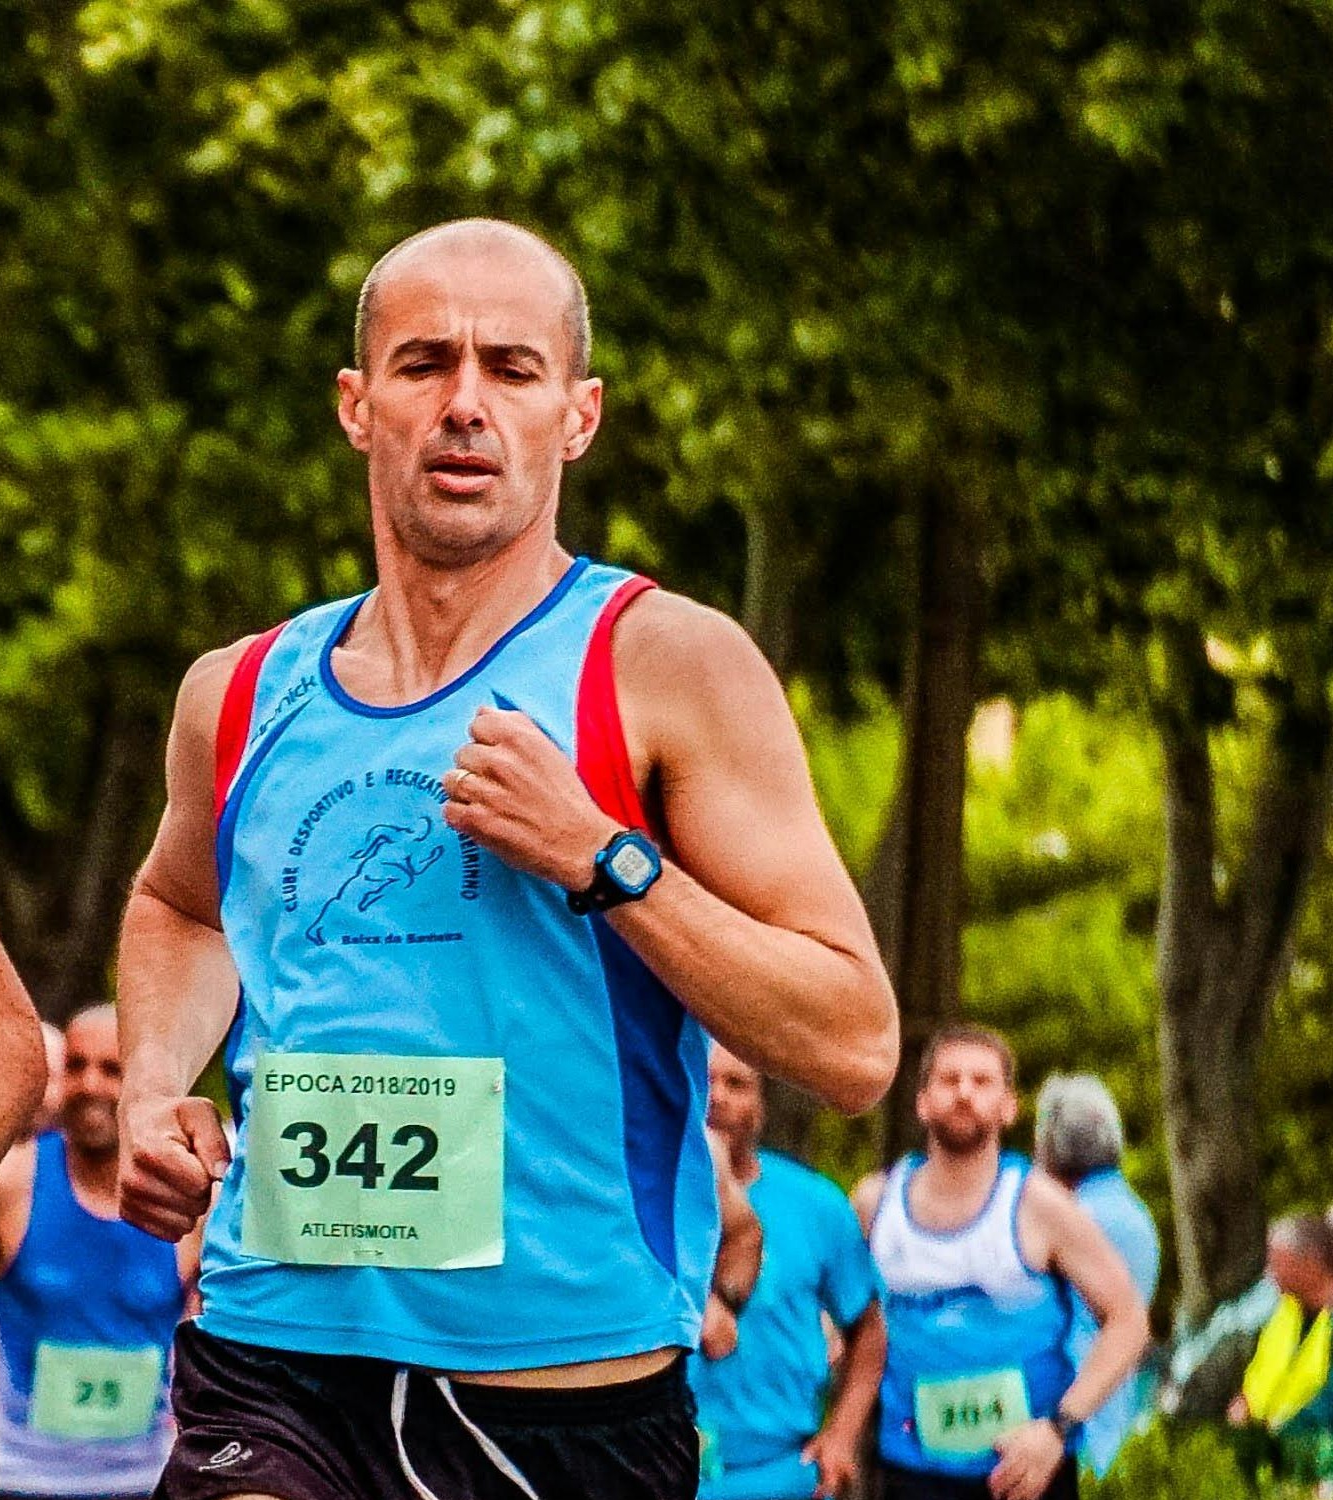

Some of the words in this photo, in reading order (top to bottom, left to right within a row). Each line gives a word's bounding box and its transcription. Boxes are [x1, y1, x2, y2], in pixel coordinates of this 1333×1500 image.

[365, 771, 375, 788] E
[385, 768, 450, 804] RECREATIV
[288, 779, 355, 857] DESPORTIVO
[283, 866, 299, 912] CLUBE
[265, 1069, 346, 1093] ÉPOCA
[351, 1076, 455, 1096] 2018/2019
[279, 1121, 439, 1191] 342
[300, 1223, 419, 1240] ATLETISMOITA
